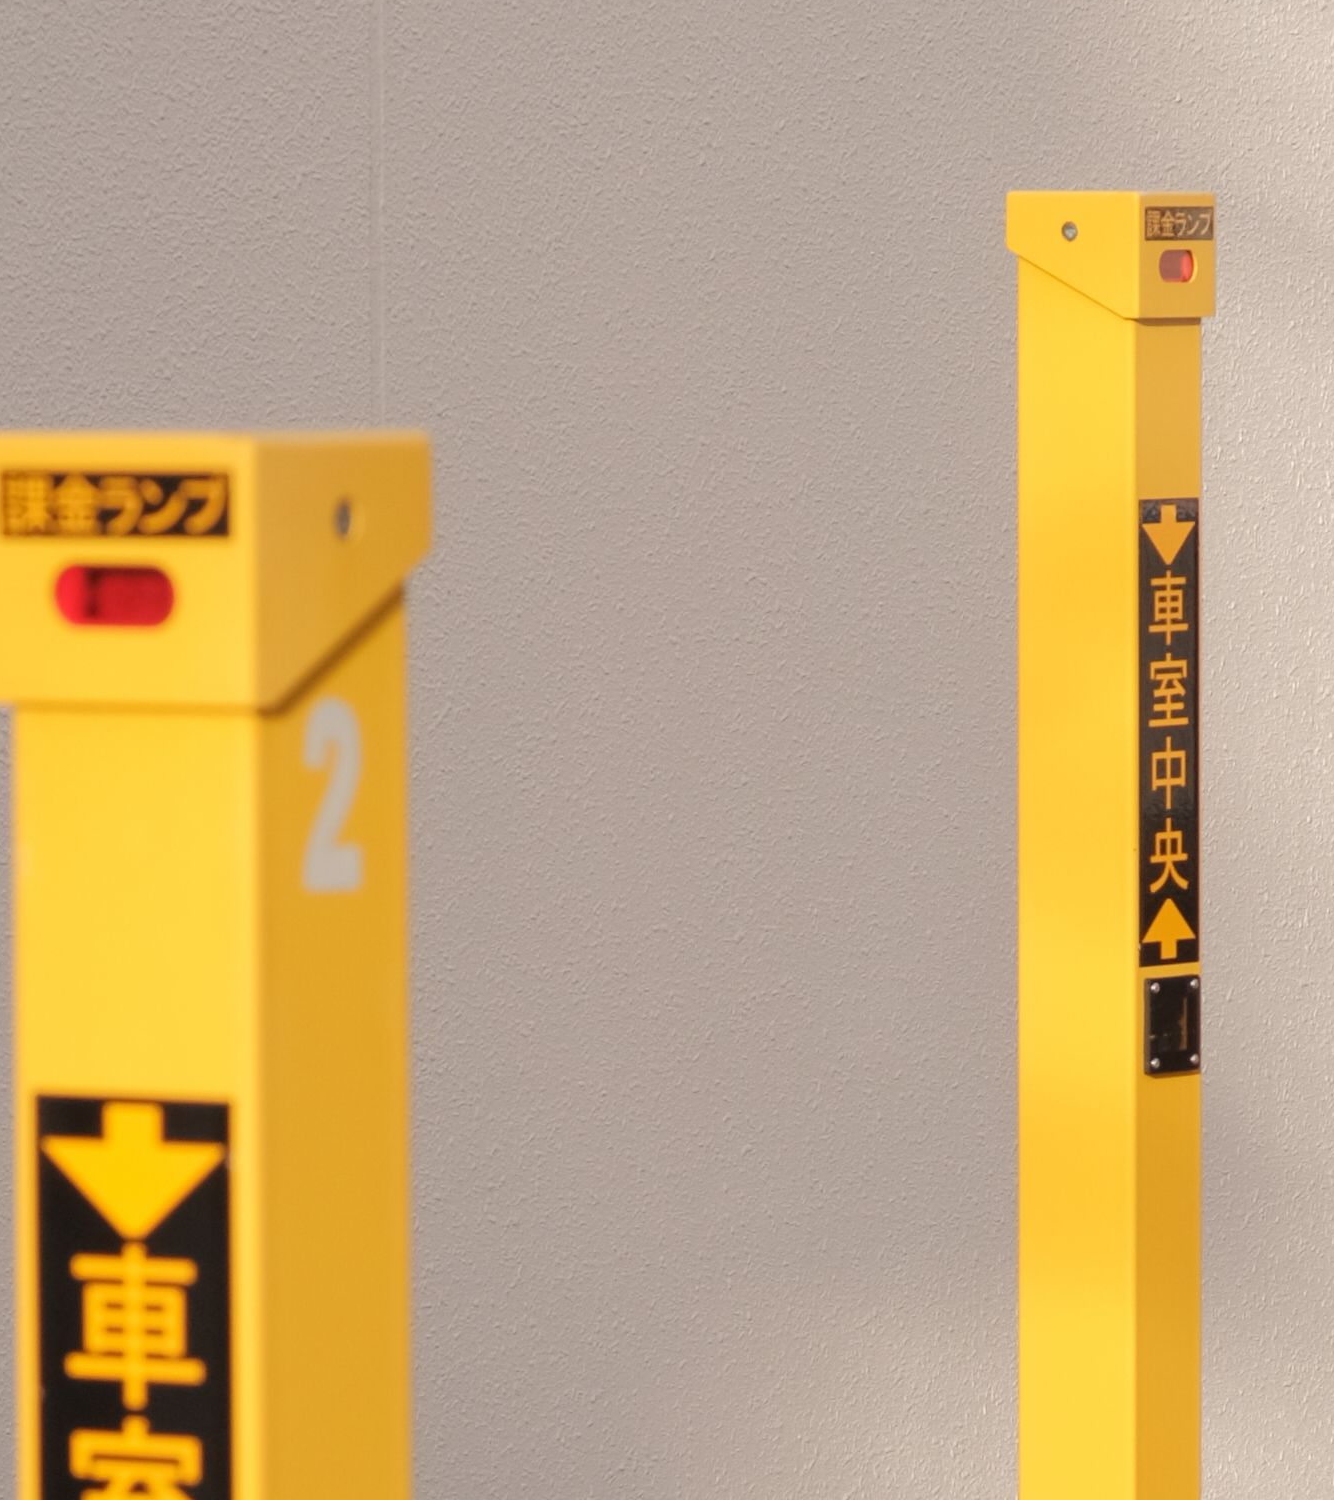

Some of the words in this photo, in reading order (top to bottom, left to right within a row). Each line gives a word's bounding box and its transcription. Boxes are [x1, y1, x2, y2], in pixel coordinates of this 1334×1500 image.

[1146, 209, 1212, 238] 課金ランプ
[302, 697, 364, 893] 2
[1148, 569, 1190, 893] 車室中央
